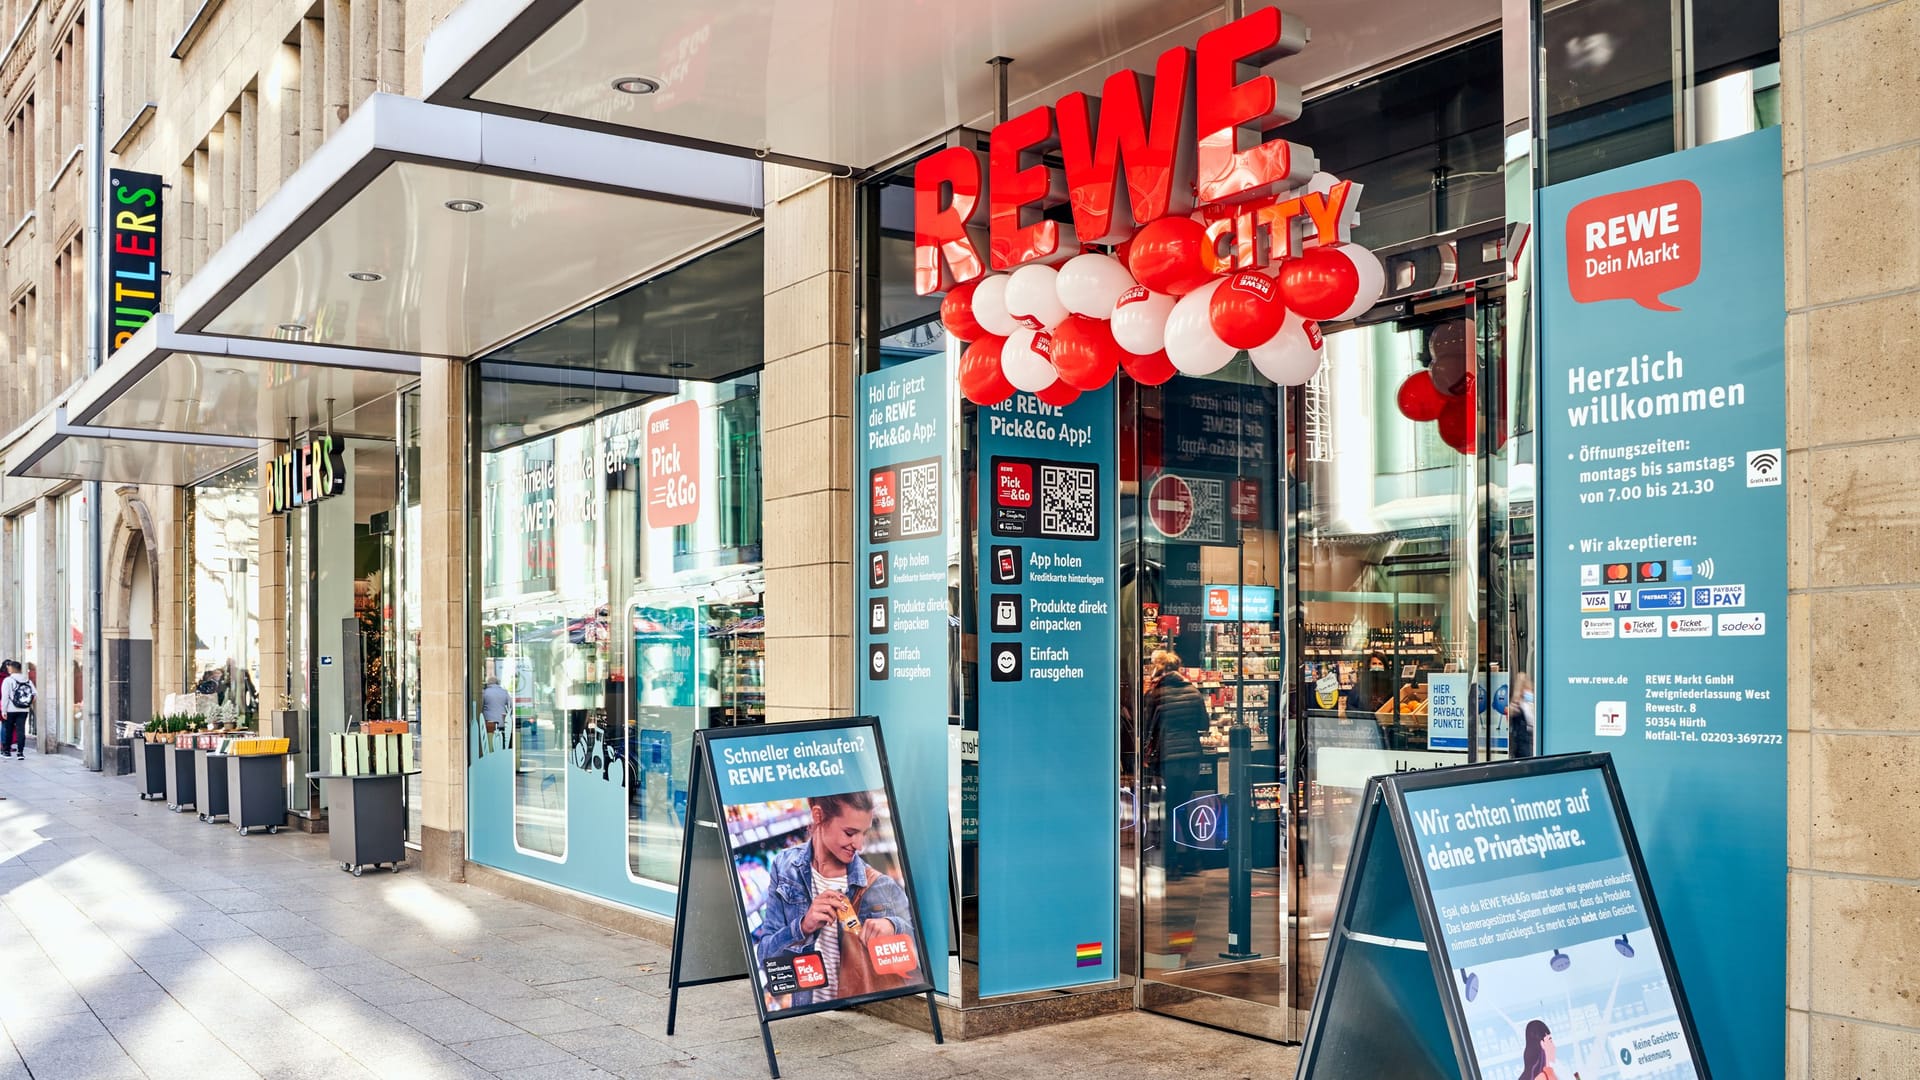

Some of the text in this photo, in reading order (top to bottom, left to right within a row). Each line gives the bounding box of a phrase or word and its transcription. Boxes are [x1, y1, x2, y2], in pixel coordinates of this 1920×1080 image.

[915, 6, 1292, 296] REWE
[1203, 180, 1353, 275] CITY
[1586, 203, 1680, 251] REWE
[1586, 242, 1680, 278] Dein Markt
[1240, 280, 1269, 294] REWE
[1568, 351, 1683, 394] Herzlich
[869, 376, 925, 404] Hol dir jetzt
[869, 399, 916, 427] die REWE
[1568, 383, 1745, 427] willkommen
[651, 419, 670, 434] REWE
[869, 418, 936, 450] Pick&Go App!
[990, 416, 1091, 447] Pick&Go App!
[1580, 438, 1690, 462] Öffnungszeiten:
[652, 443, 680, 478] Pick
[266, 435, 334, 514] BUTLERS
[1580, 456, 1735, 483] montags bis samstags
[875, 485, 888, 496] Pick
[1001, 476, 1020, 488] Pick
[666, 474, 696, 508] &Go
[1011, 489, 1030, 501] &Go
[1580, 479, 1714, 503] von 7.00 bis 21.30
[881, 496, 894, 508] &Go
[1580, 533, 1697, 553] Wir akzeptieren:
[894, 552, 929, 570] App holen
[1030, 552, 1082, 569] App holen
[1030, 572, 1104, 585] Kreditkarte hinterlegen
[894, 597, 948, 614] Produkte direkt
[1586, 597, 1606, 606] VISA
[1619, 592, 1626, 602] V
[1713, 593, 1742, 605] PAY
[1030, 598, 1107, 614] Produkte direkt
[894, 616, 929, 633] einpacken
[1030, 617, 1081, 633] einpacken
[1722, 620, 1762, 631] sodexo
[894, 646, 920, 660] Einfach
[1030, 647, 1069, 661] Einfach
[894, 663, 931, 680] rausgehen
[1030, 665, 1084, 682] rausgehen
[1568, 675, 1628, 685] www.rewe.de
[1645, 675, 1734, 685] REWE Markt GmbH
[1433, 684, 1450, 694] HIER
[1645, 689, 1770, 701] Zweigniederlassung West
[1433, 696, 1456, 705] GIBT'S
[1645, 703, 1696, 713] Rewestr. 8
[1433, 707, 1464, 717] PAYBACK
[1433, 719, 1464, 728] PUNKTE!
[1645, 717, 1706, 727] 50354 Hürth
[1645, 731, 1782, 744] Notfall-Tel. 02203-3697272
[724, 736, 864, 765] Schneller einkaufen?
[729, 759, 844, 786] REWE Pick&Go!
[1414, 788, 1590, 836] Wir achten immer auf
[1428, 825, 1585, 871] deine Privatsphäre.
[1470, 902, 1479, 912] du
[1480, 897, 1501, 910] REWE
[1501, 891, 1530, 906] Pick&Go
[1549, 885, 1564, 896] oder
[1565, 883, 1576, 893] wie
[1446, 924, 1461, 934] Das
[1516, 907, 1541, 922] System
[1542, 902, 1566, 915] erkennt
[1580, 896, 1594, 907] dass
[1595, 894, 1603, 904] du
[1603, 889, 1631, 903] Produkte
[1451, 937, 1478, 950] nimmst
[1479, 933, 1494, 945] oder
[1536, 922, 1545, 933] Es
[1546, 919, 1566, 930] merkt
[1567, 915, 1580, 926] sich
[1581, 912, 1598, 924] nicht
[1598, 909, 1612, 920] dein
[875, 941, 907, 956] REWE
[877, 954, 910, 966] Dein Markt
[798, 964, 814, 974] Pick
[808, 973, 823, 982] &Go
[1632, 1031, 1680, 1050] Keine Gesichts-
